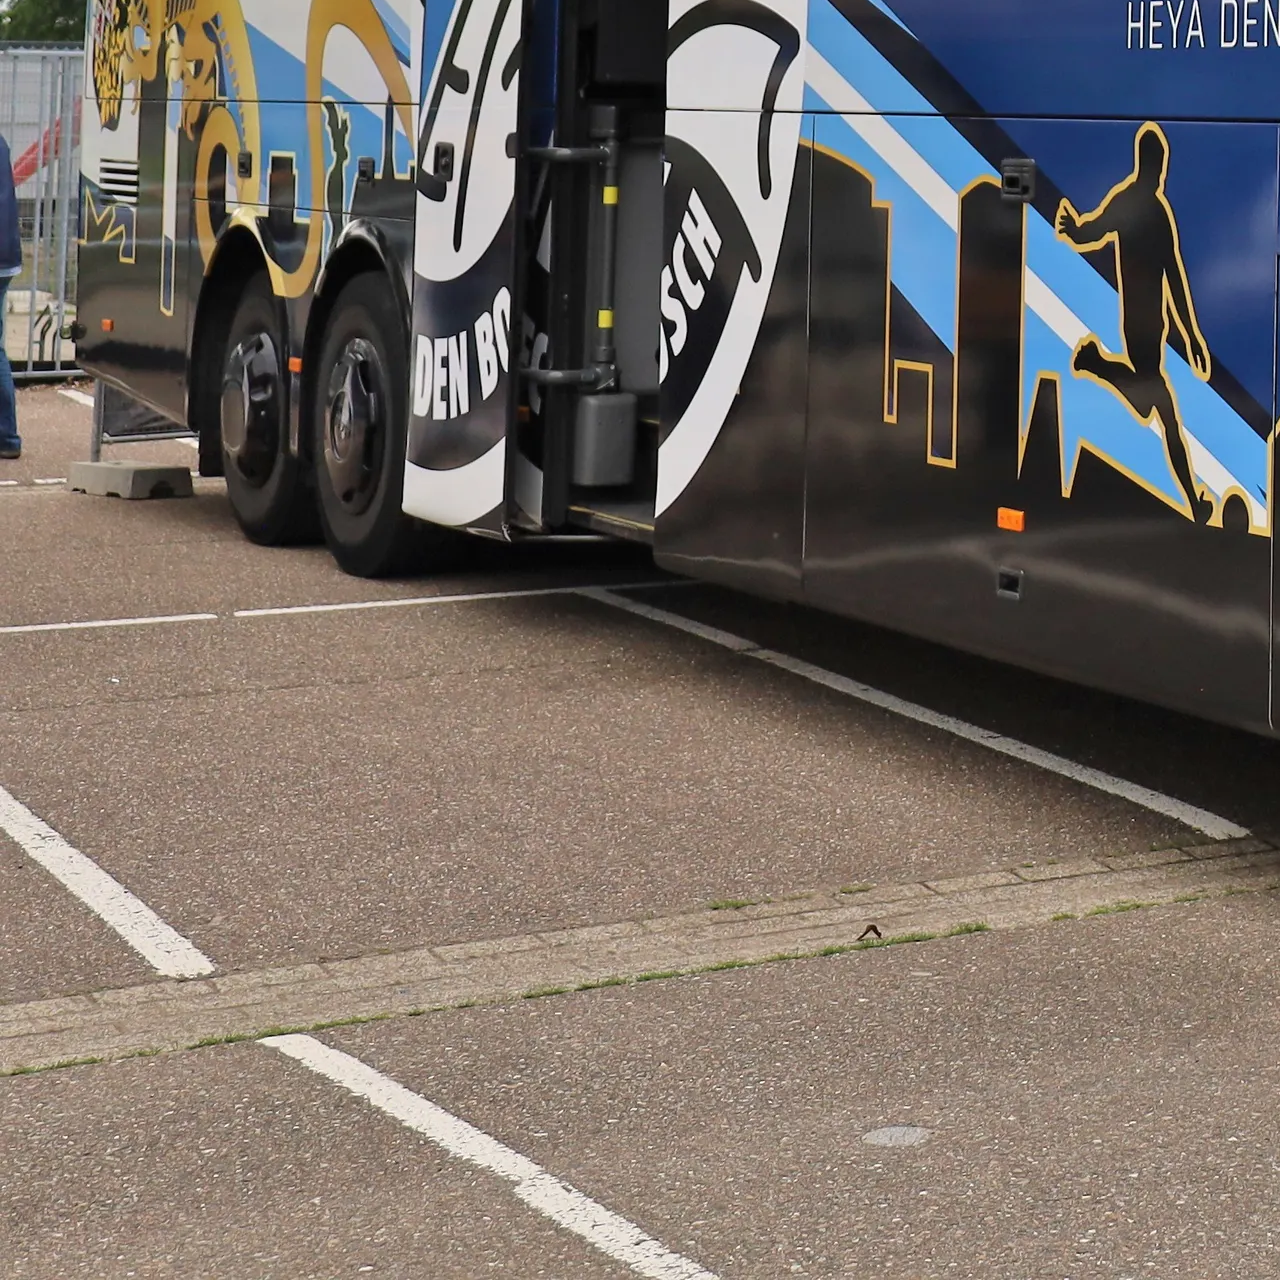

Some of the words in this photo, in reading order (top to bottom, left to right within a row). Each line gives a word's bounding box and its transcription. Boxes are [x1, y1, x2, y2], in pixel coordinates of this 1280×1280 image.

[1126, 0, 1205, 49] HEYA
[659, 187, 723, 385] SCH
[413, 330, 470, 421] DEN
